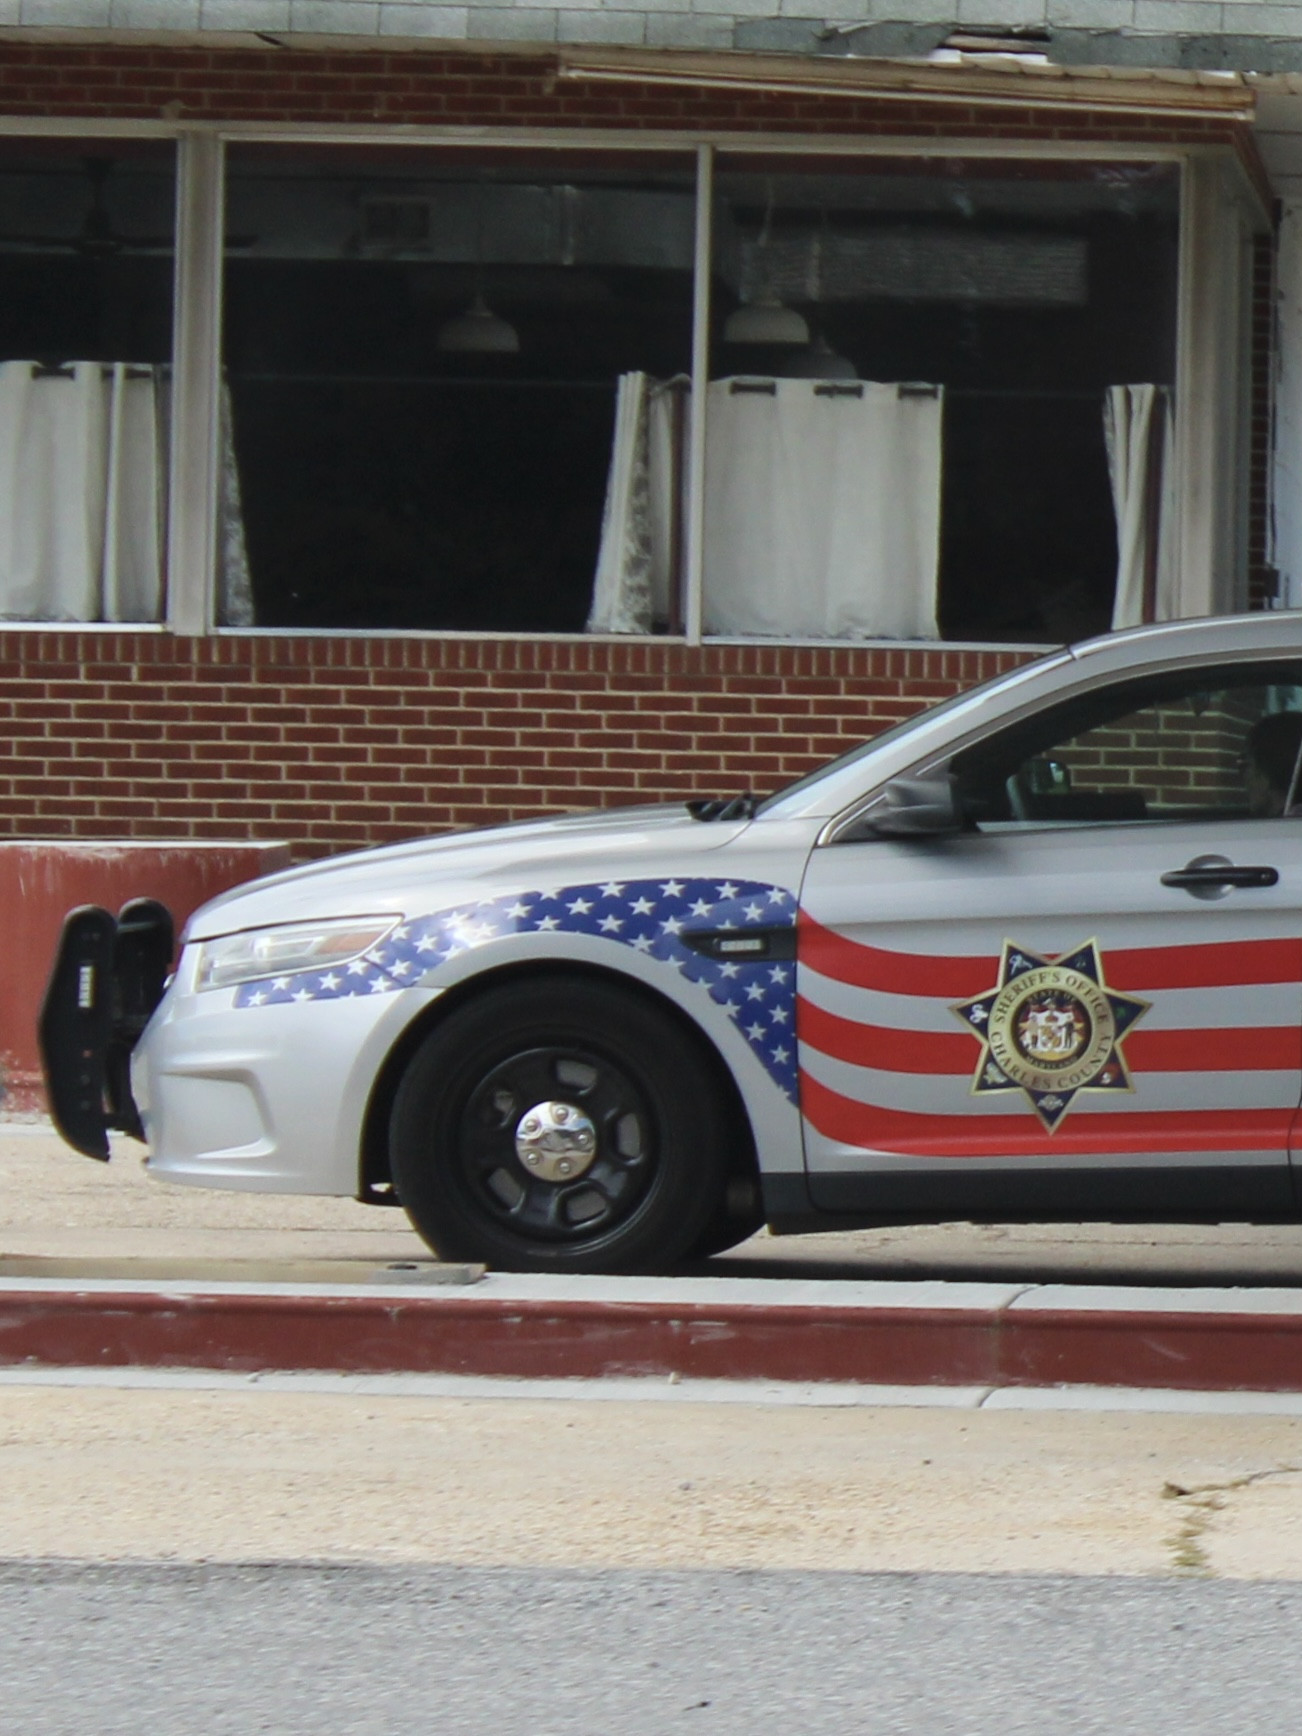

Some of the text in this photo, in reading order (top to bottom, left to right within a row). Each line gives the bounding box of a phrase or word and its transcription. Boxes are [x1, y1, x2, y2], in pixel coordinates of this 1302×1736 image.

[993, 970, 1110, 1024] SHERIFF'S OFFICE
[989, 1031, 1113, 1090] CHARLES COUNTY
